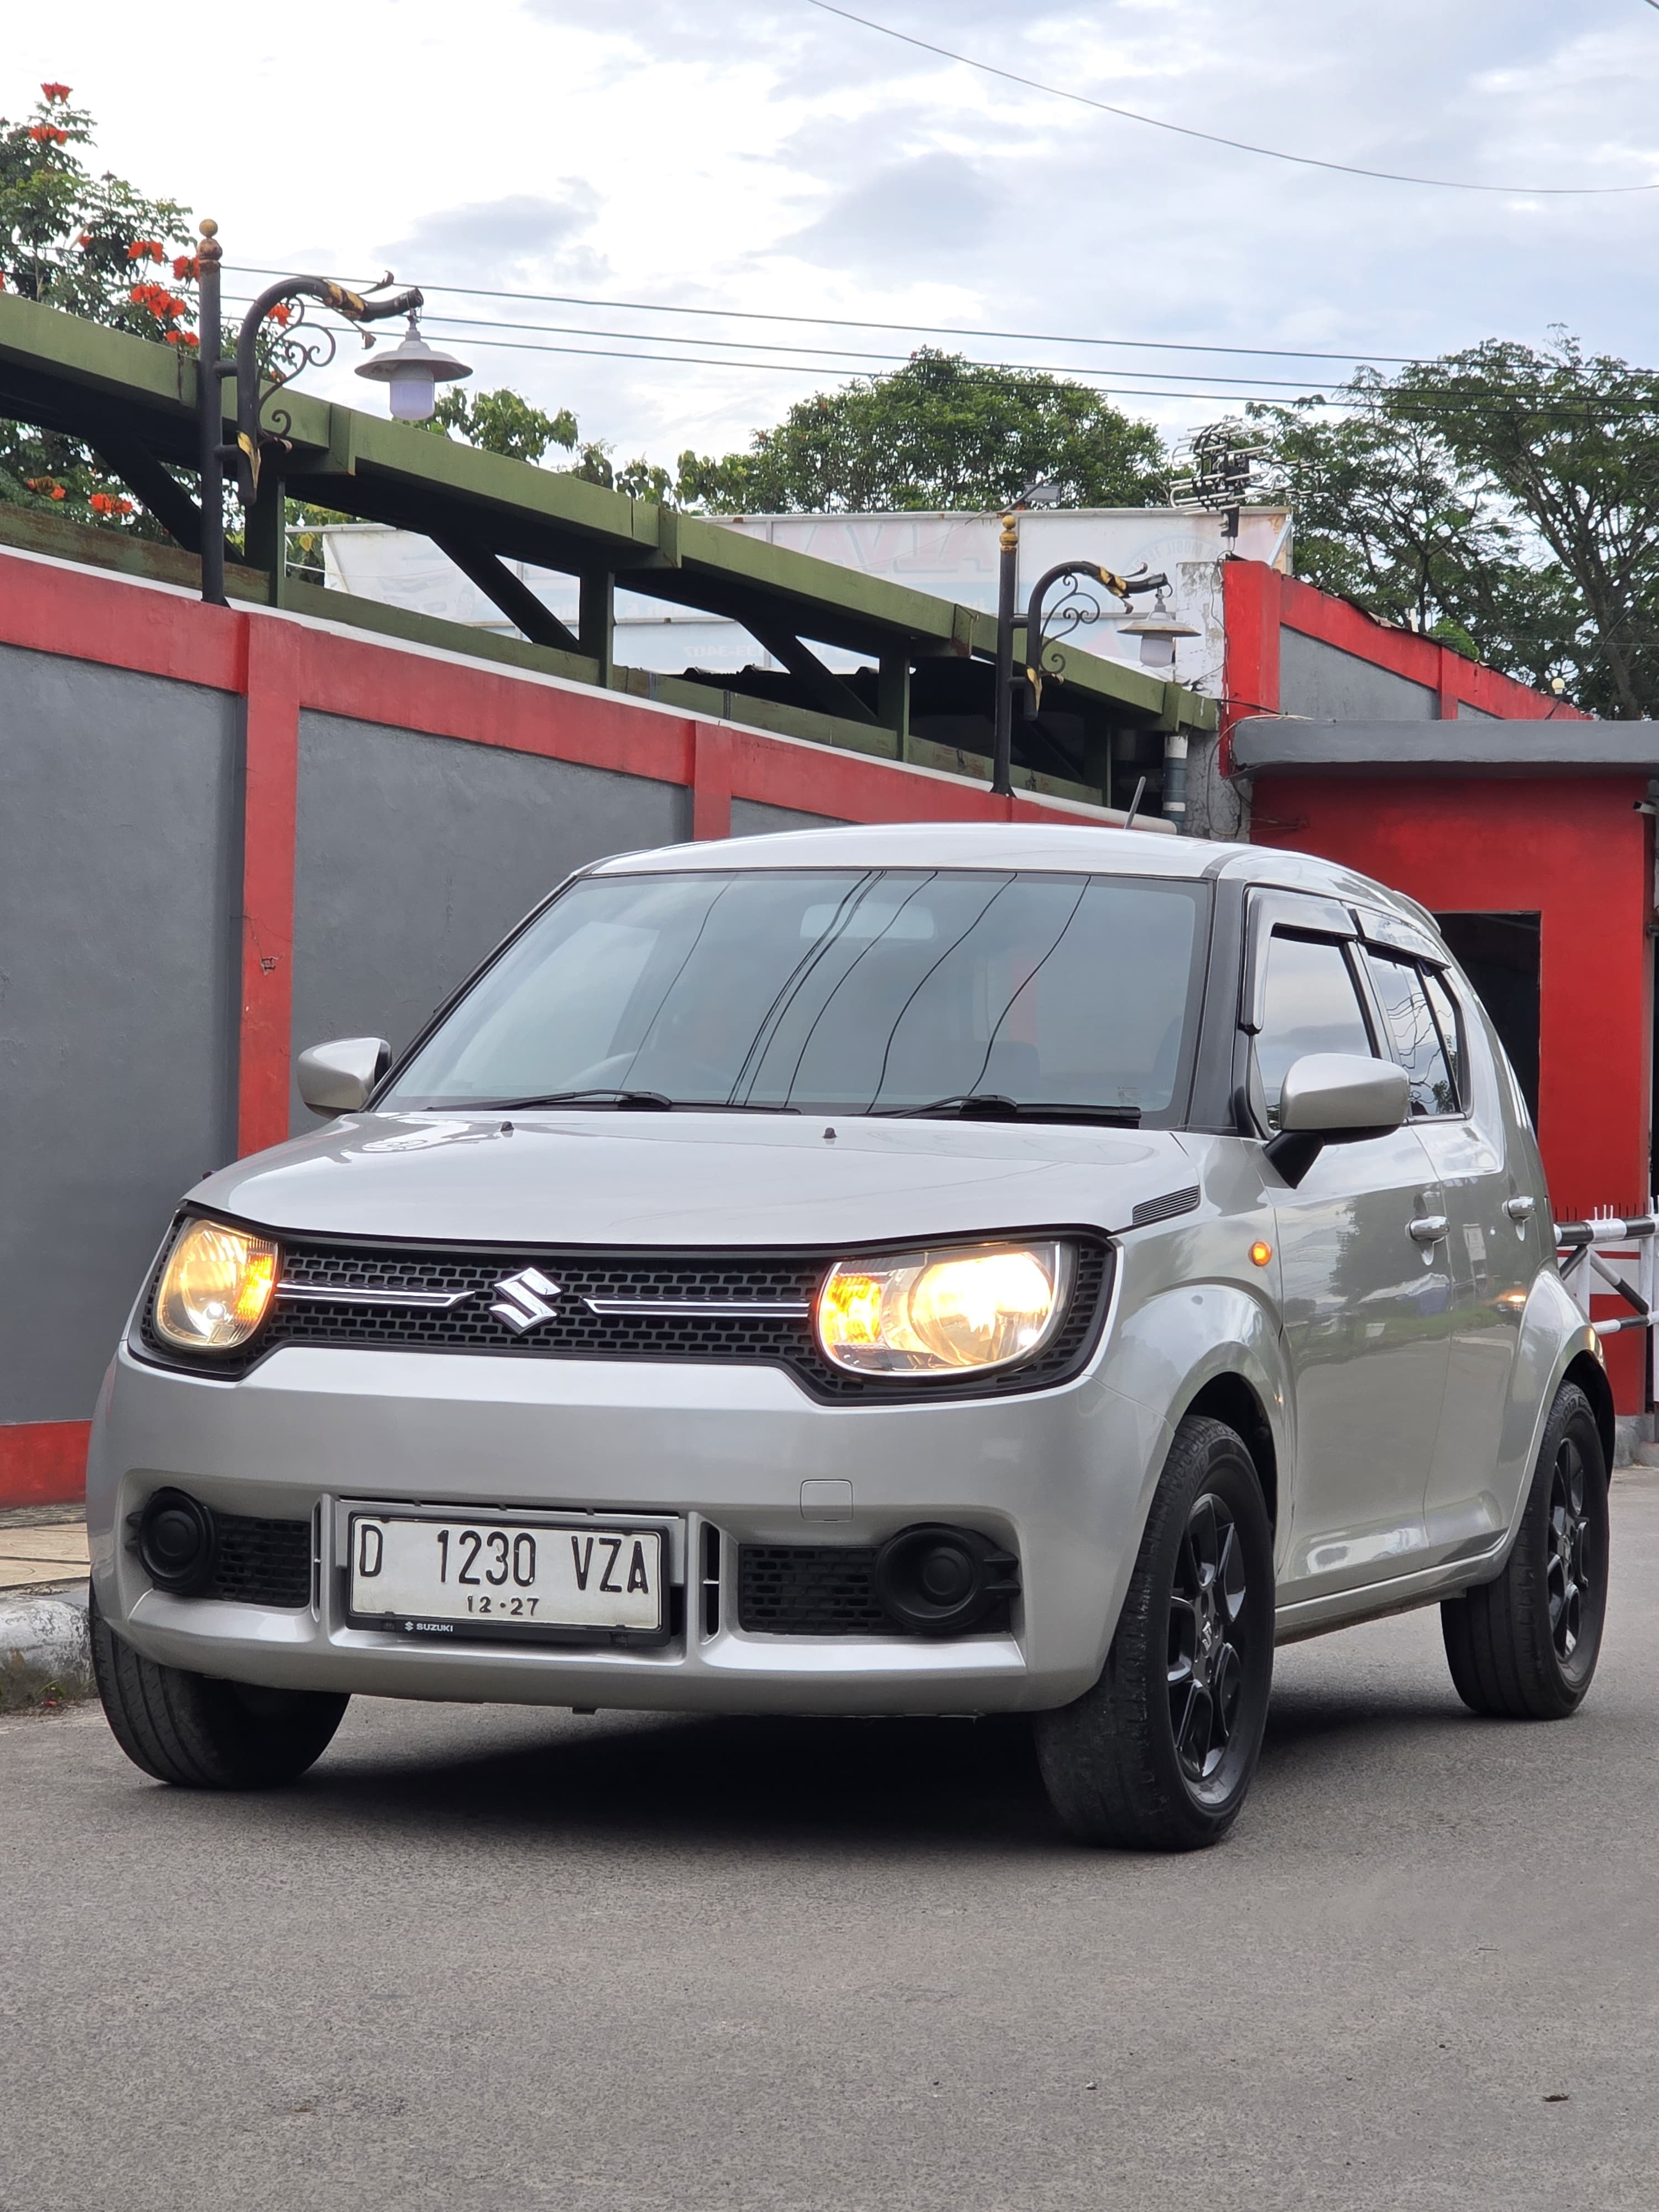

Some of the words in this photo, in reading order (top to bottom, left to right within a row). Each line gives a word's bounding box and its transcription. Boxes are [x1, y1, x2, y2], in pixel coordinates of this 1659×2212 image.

[359, 1524, 383, 1577] D
[437, 1530, 536, 1587] 1230
[571, 1536, 649, 1594] VZA
[416, 1623, 453, 1632] SUZUKI
